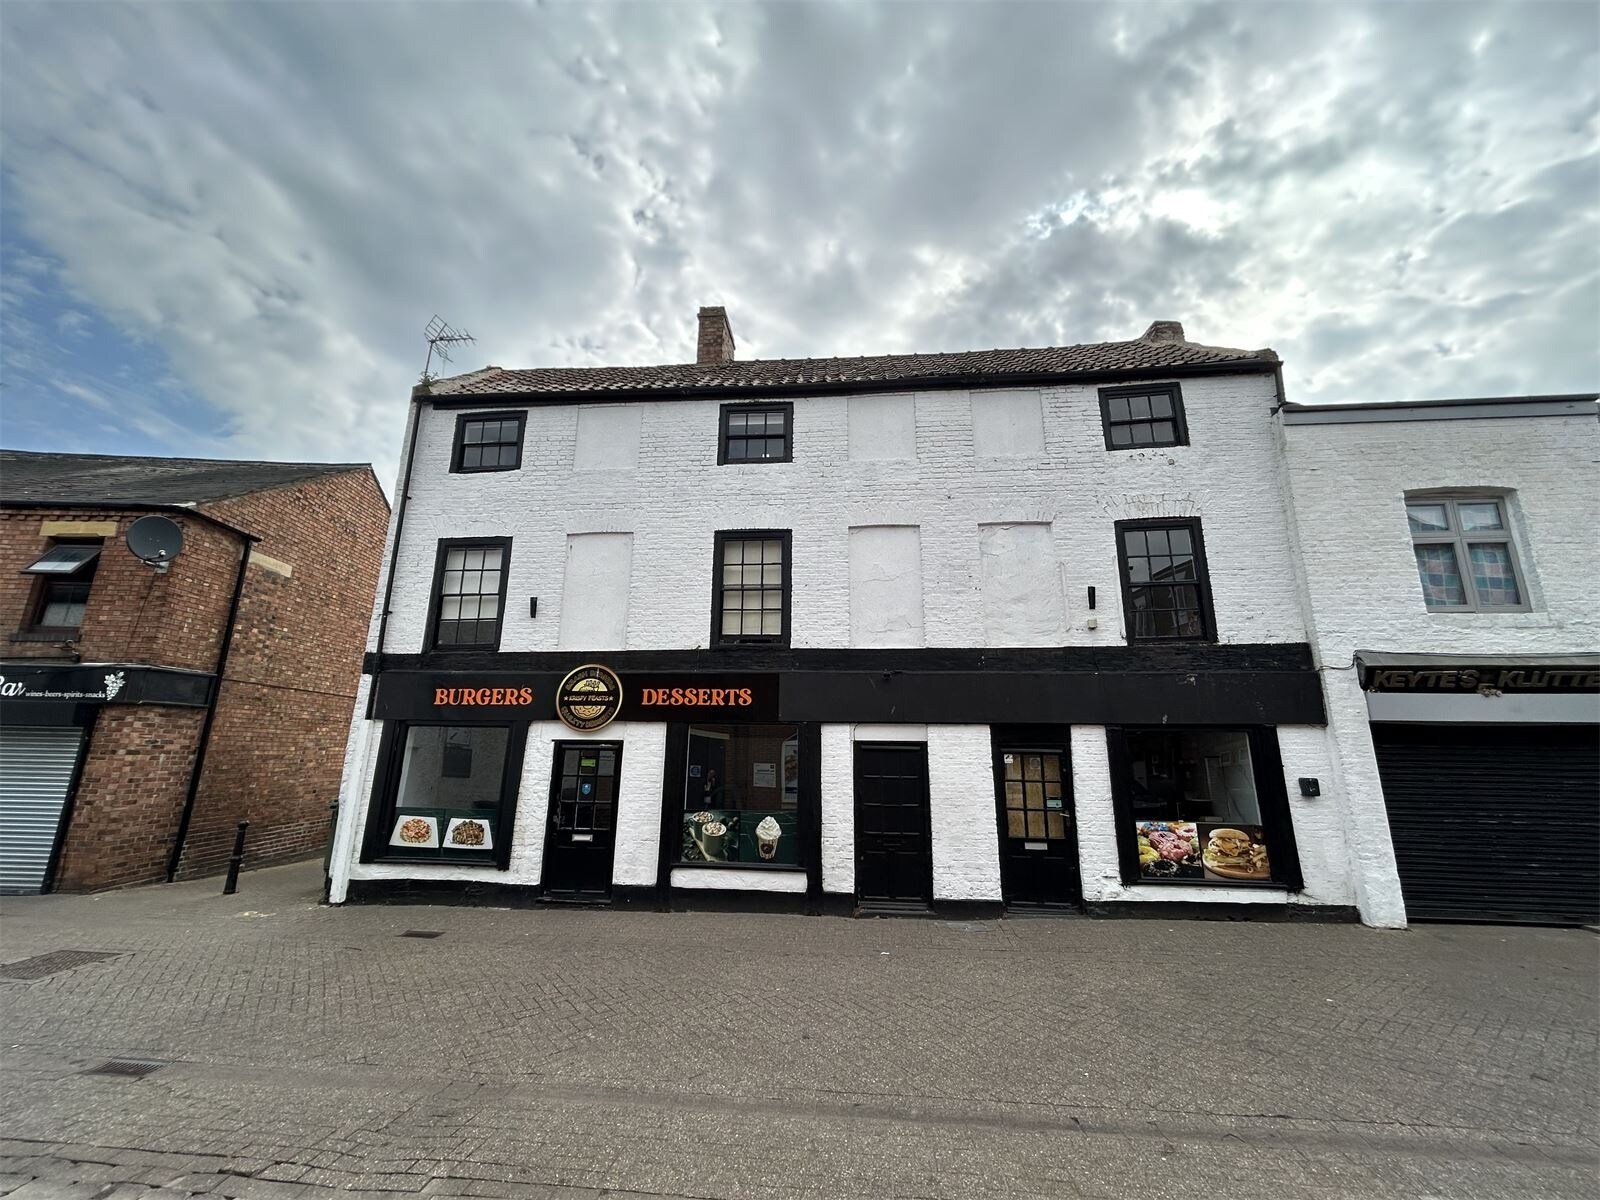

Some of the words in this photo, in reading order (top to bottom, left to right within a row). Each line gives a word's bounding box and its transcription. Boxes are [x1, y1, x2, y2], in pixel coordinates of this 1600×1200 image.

[1373, 669, 1480, 689] KEYTE'S
[433, 687, 533, 706] BURGERS
[641, 687, 752, 706] DESSERTS
